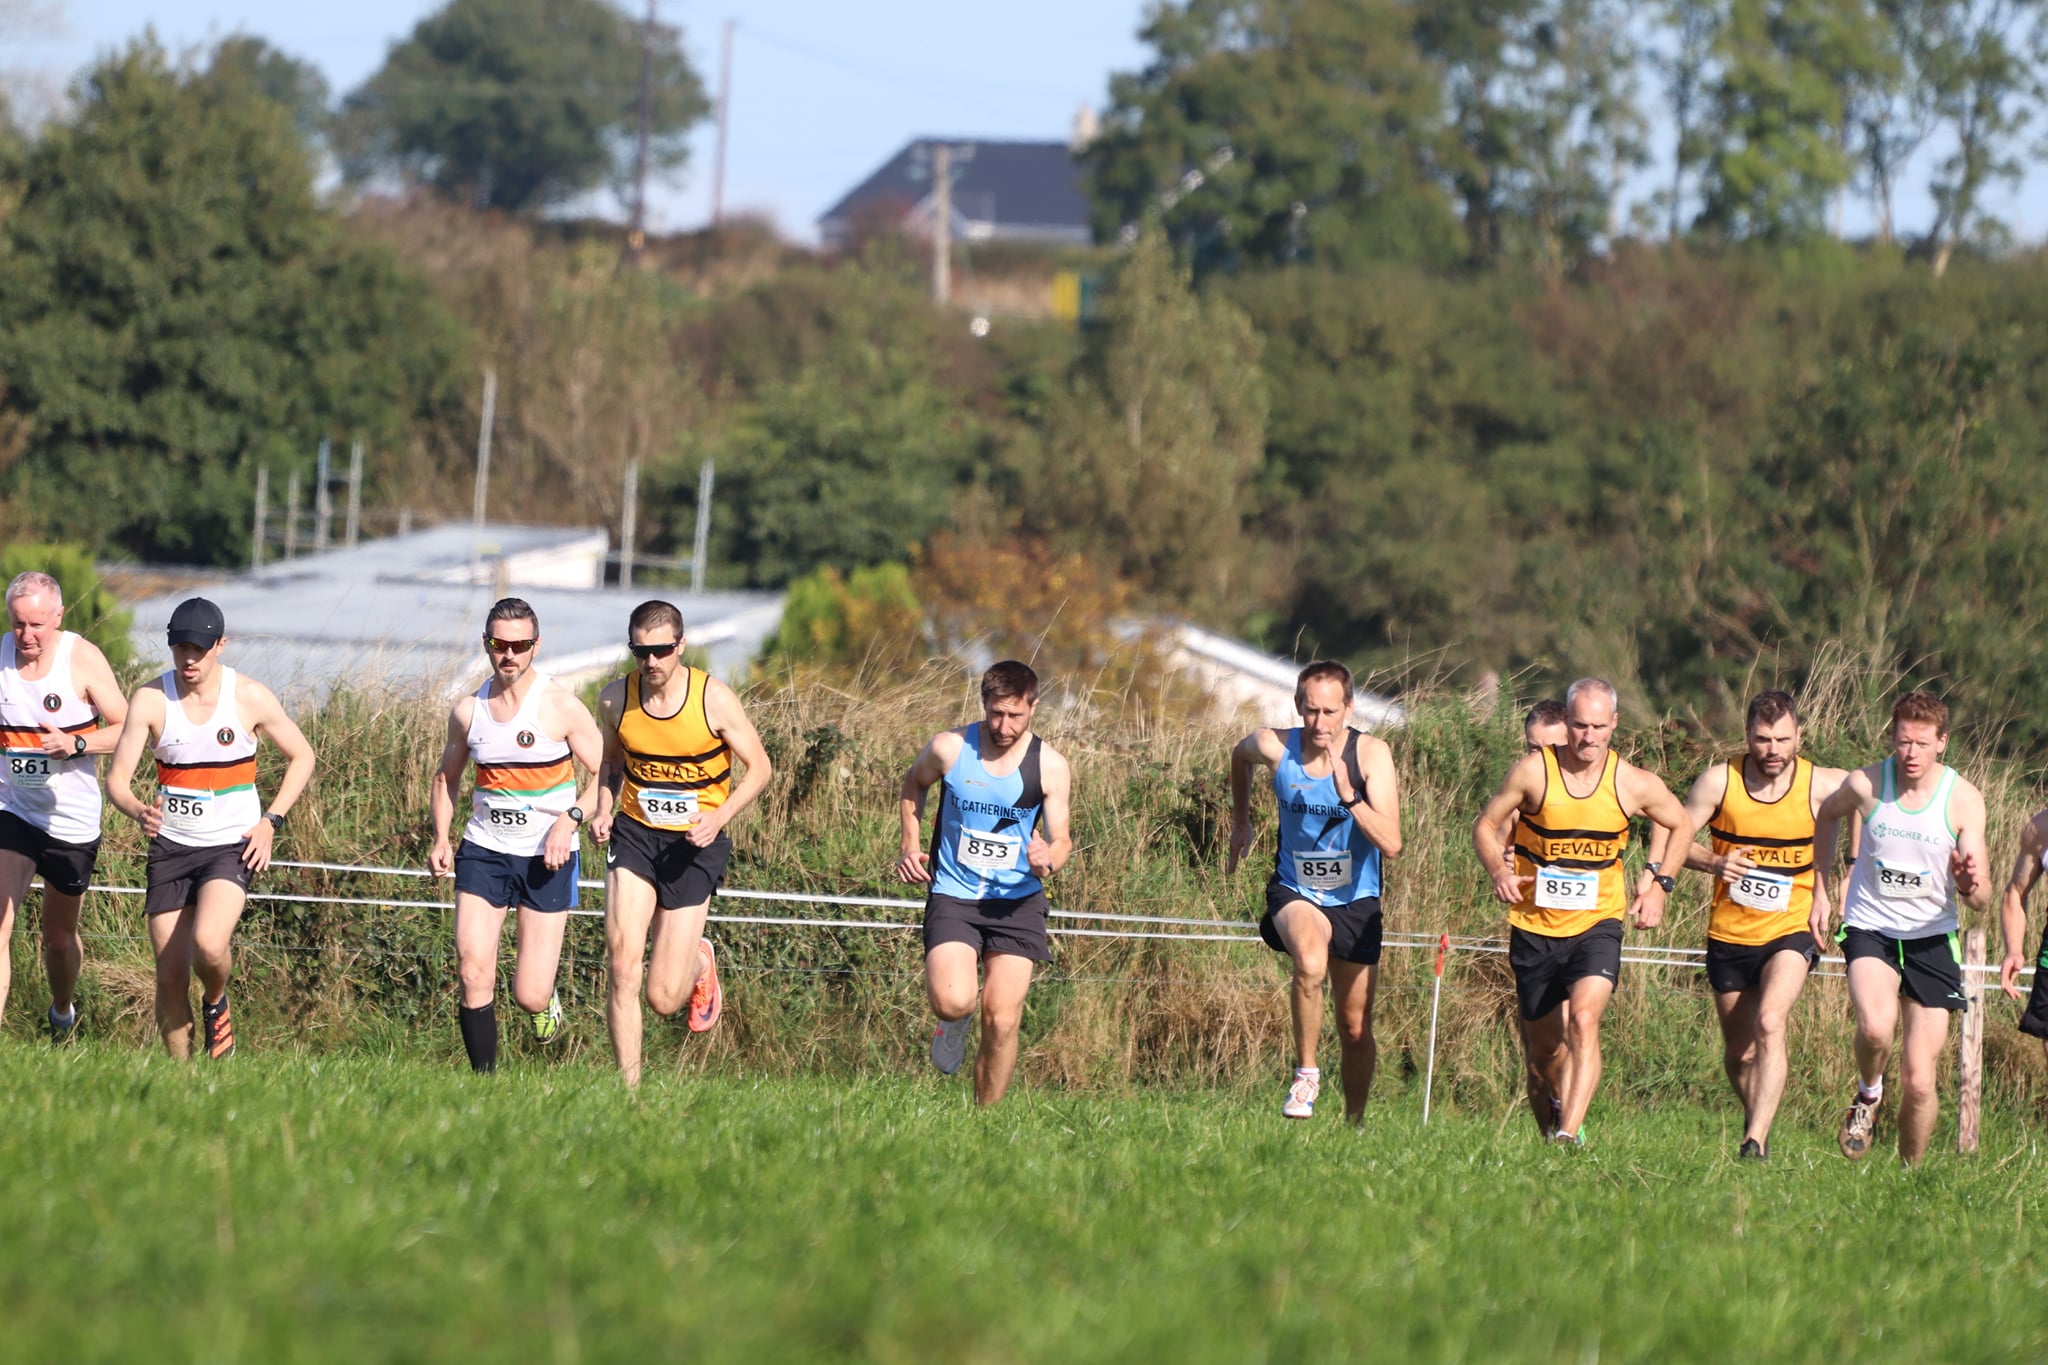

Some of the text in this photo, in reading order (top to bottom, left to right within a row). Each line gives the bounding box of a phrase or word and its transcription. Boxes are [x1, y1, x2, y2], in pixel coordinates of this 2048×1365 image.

[12, 759, 50, 774] 861
[168, 797, 203, 817] 856
[647, 799, 688, 813] 848
[1291, 803, 1350, 817] CATHERINES
[490, 809, 527, 825] 858
[1888, 827, 1922, 841] TOGHER
[968, 840, 1008, 858] 853
[1542, 841, 1613, 857] LEEVALE
[1303, 861, 1342, 876] 854
[1881, 869, 1922, 887] 844
[1546, 880, 1587, 897] 852
[1740, 879, 1780, 899] 850
